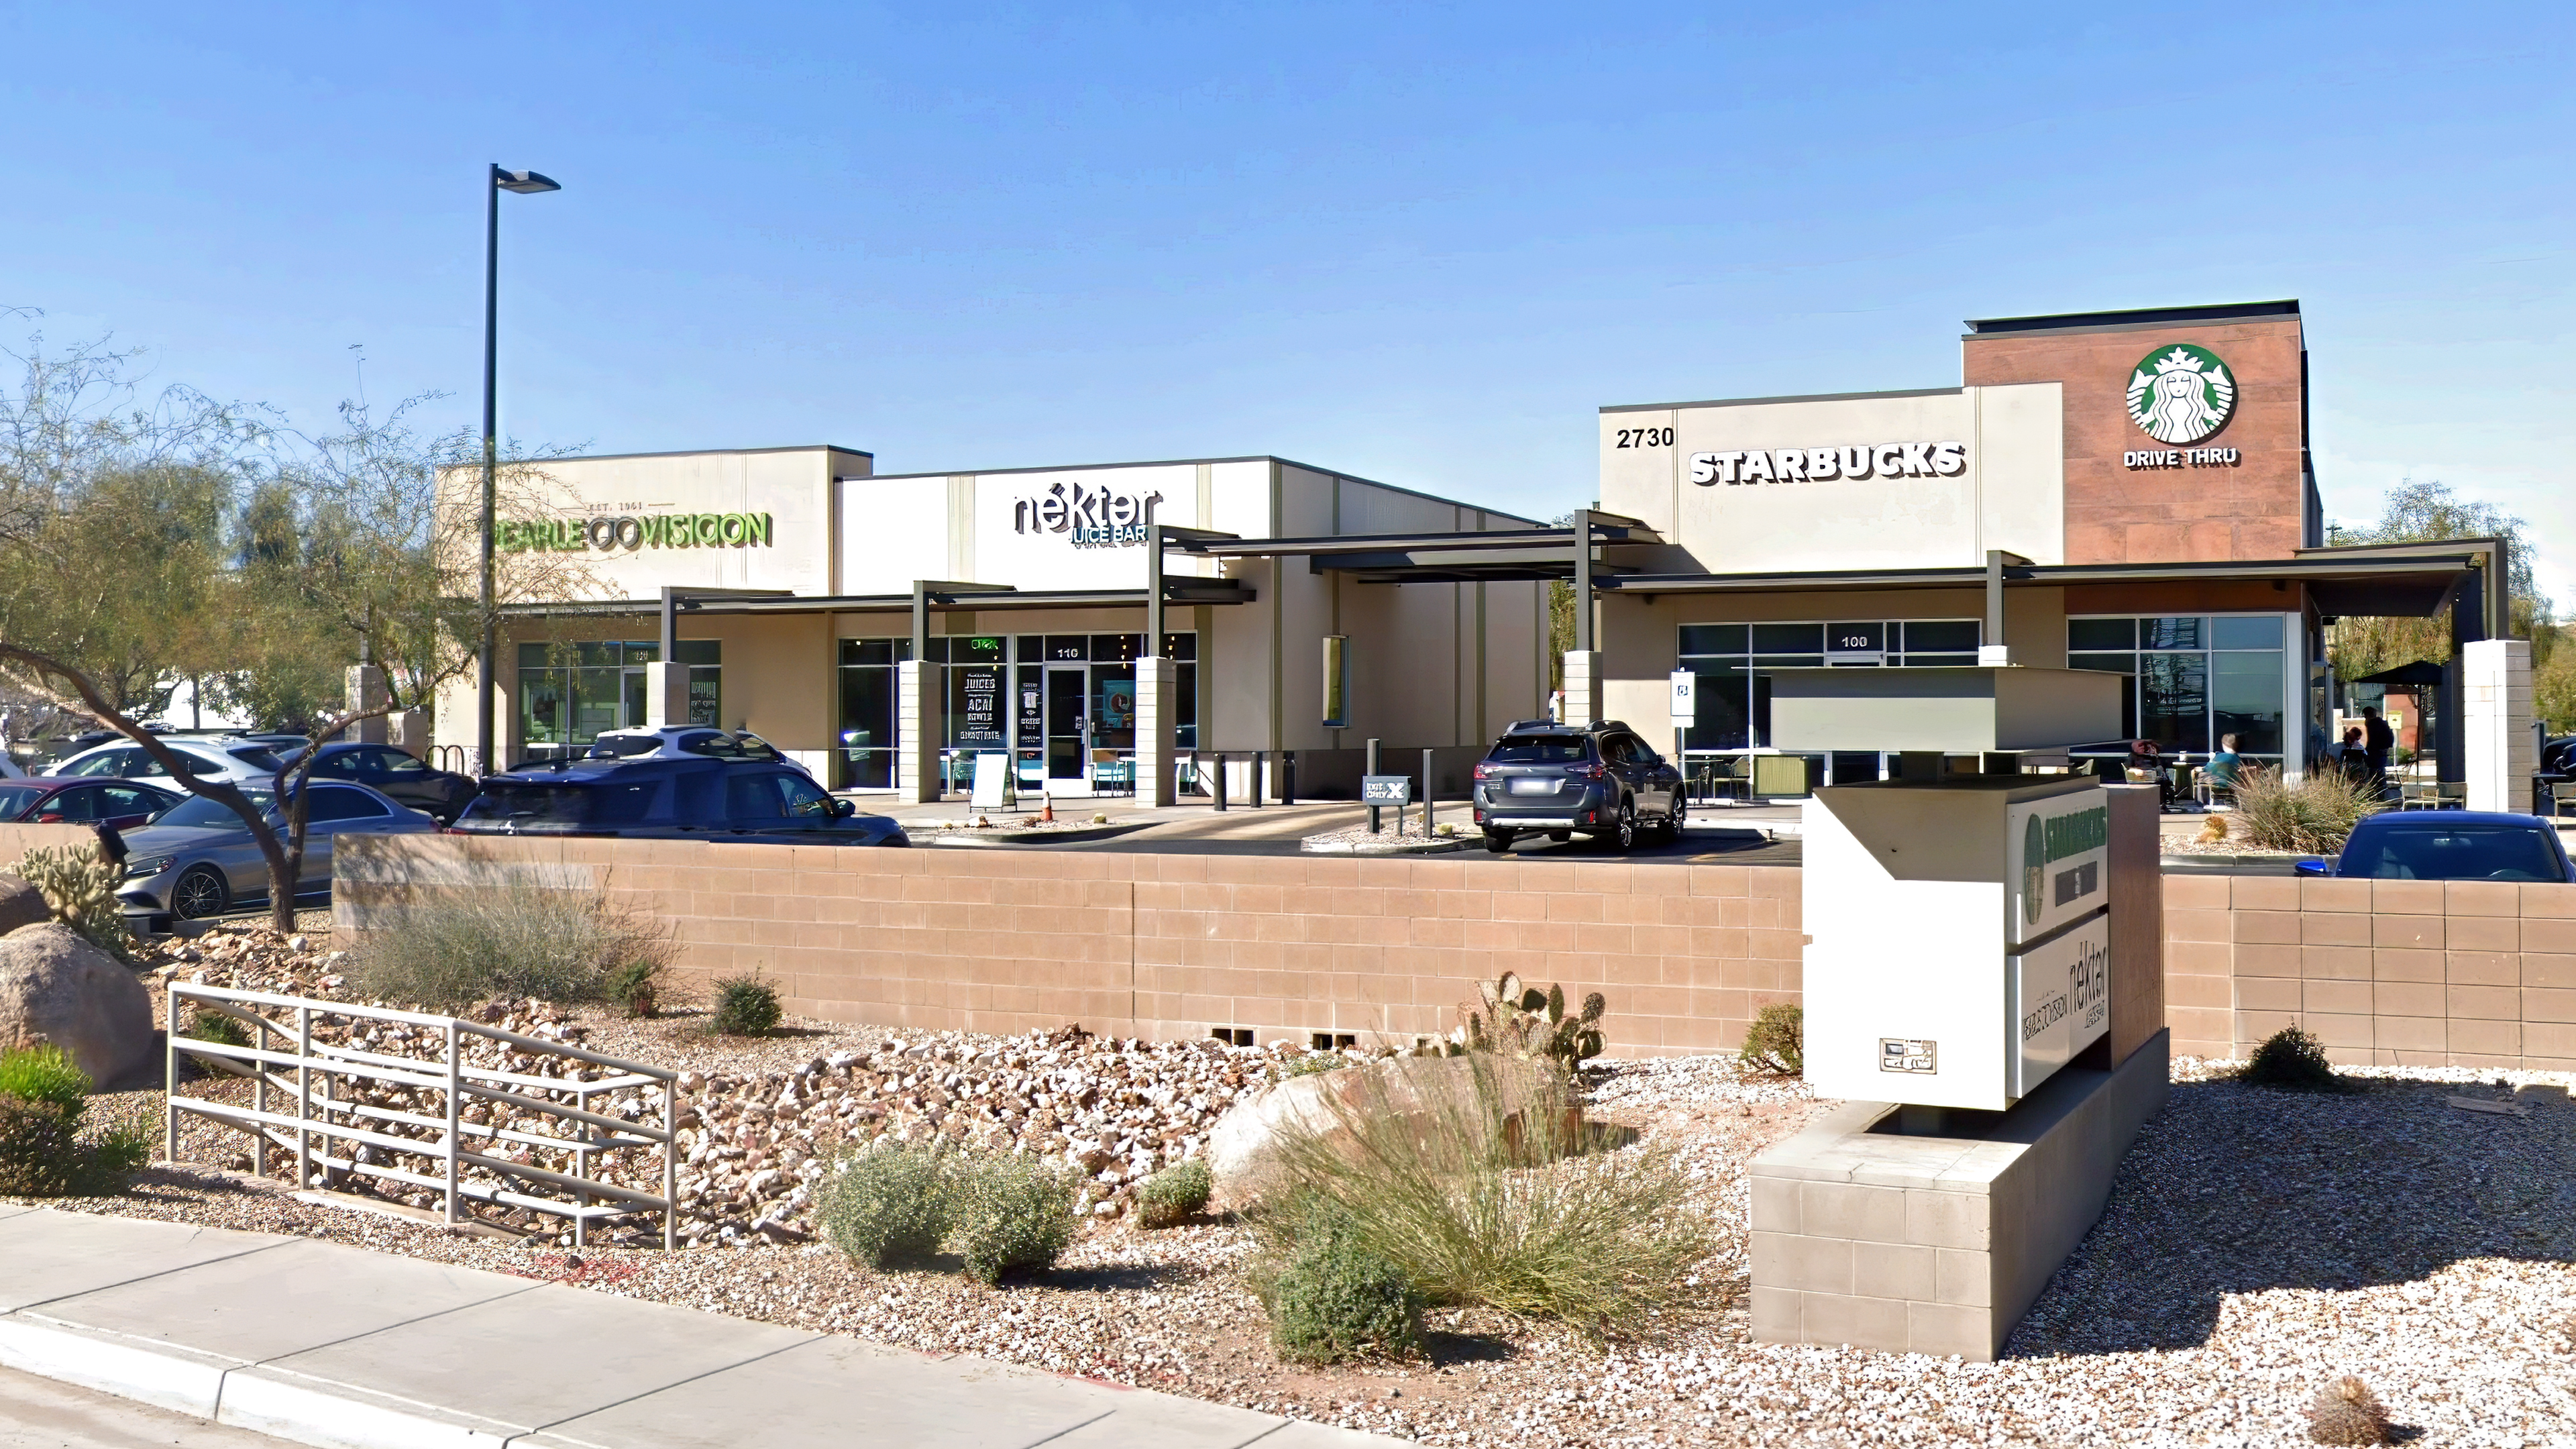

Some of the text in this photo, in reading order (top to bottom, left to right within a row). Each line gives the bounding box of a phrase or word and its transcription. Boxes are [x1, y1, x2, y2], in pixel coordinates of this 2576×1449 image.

[1617, 427, 1674, 448] 2730
[1689, 441, 1966, 486] STARBUCKS
[2123, 447, 2240, 469] DRIVE THRU
[1113, 524, 1147, 542] BAR
